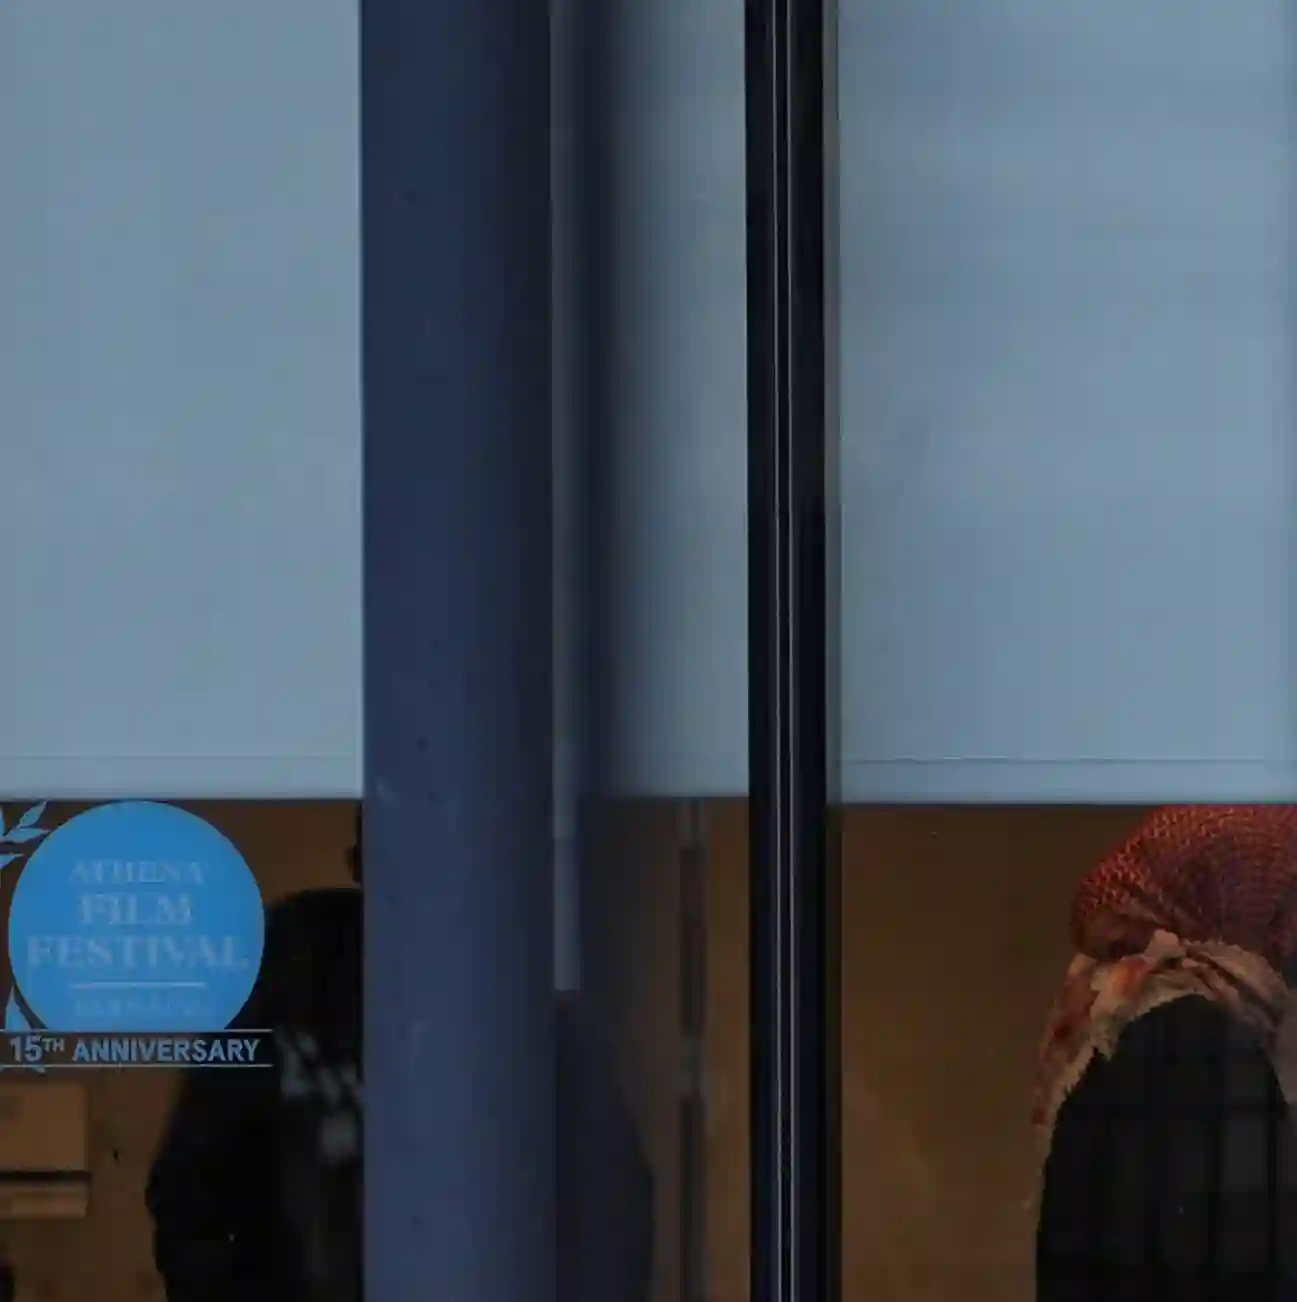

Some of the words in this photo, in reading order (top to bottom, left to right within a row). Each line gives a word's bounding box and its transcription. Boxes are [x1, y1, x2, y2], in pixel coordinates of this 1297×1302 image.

[70, 860, 206, 885] ATHENA
[79, 892, 194, 926] FILM
[26, 935, 249, 970] FESTIVAL
[72, 1038, 261, 1063] ANNIVERSARY
